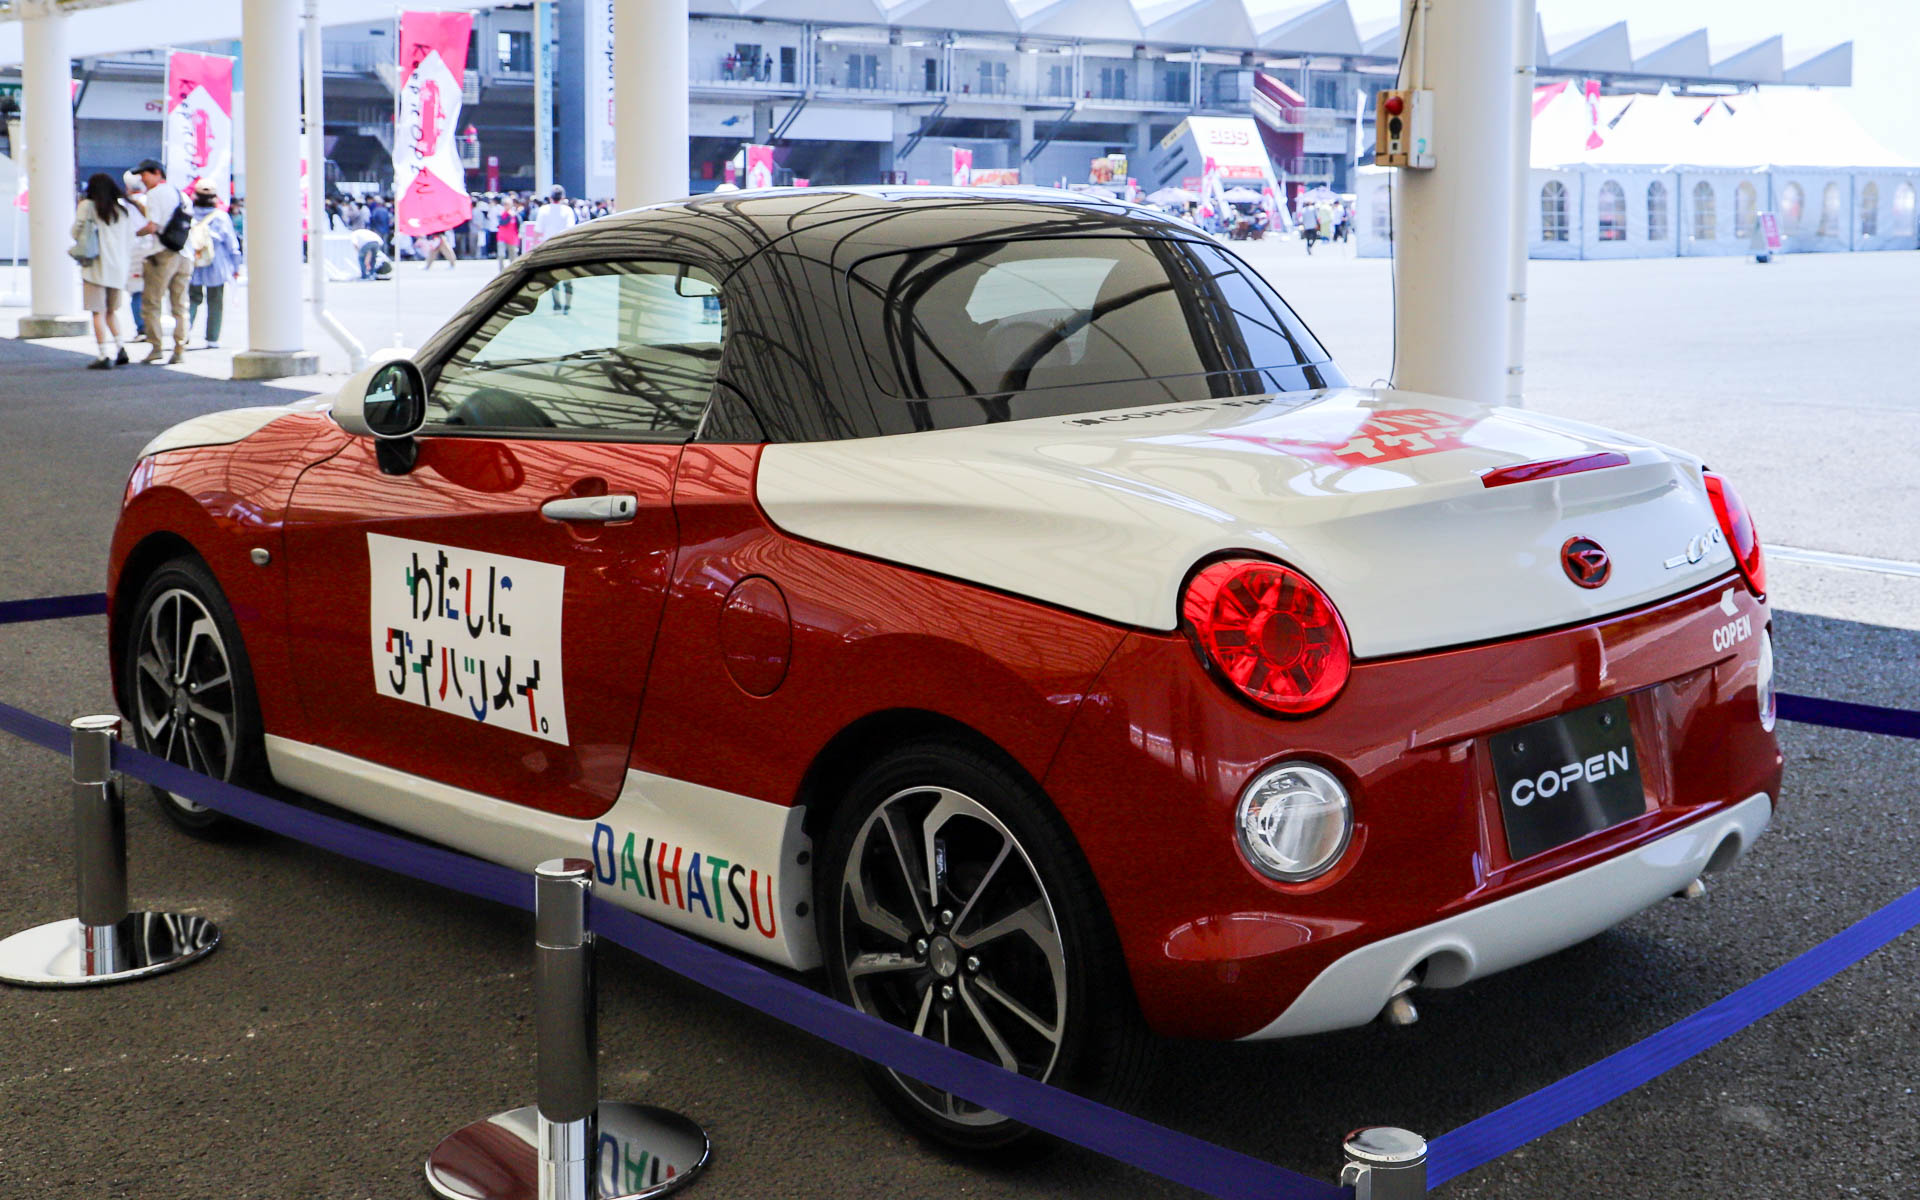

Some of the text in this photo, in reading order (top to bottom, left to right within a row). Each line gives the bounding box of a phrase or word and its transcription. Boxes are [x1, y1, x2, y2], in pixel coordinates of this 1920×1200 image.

[410, 44, 431, 95] Keep
[409, 125, 434, 195] OPEN
[1099, 405, 1216, 422] COPEN
[406, 550, 512, 639] わたしに
[1712, 613, 1753, 653] COPEN
[1511, 746, 1629, 806] COPEN
[592, 822, 776, 939] DAIHATSU
